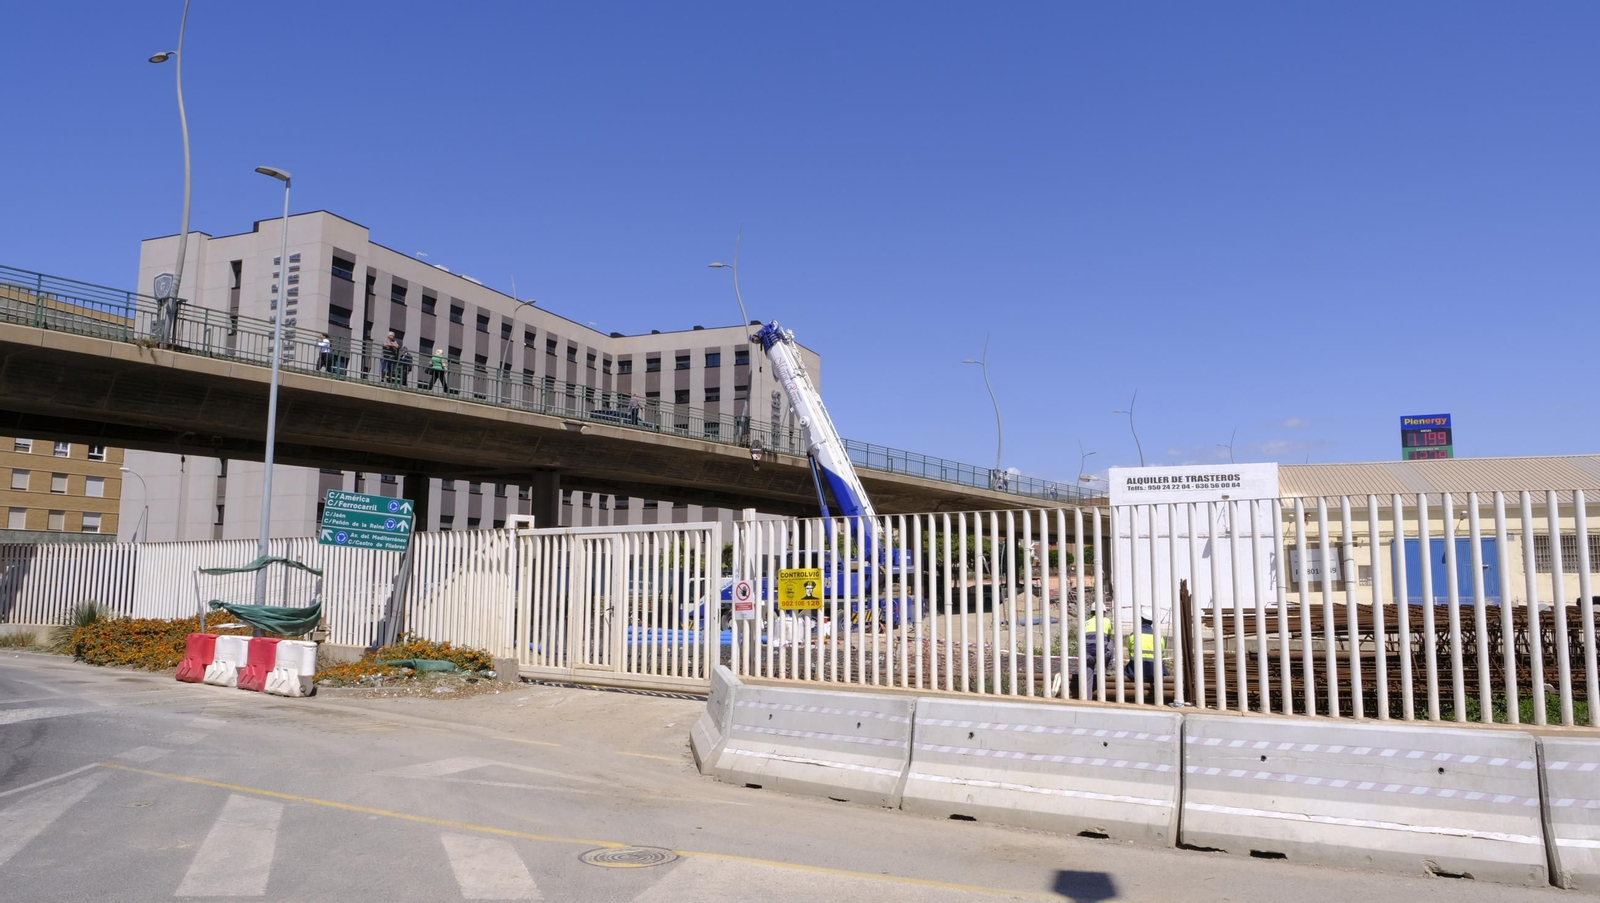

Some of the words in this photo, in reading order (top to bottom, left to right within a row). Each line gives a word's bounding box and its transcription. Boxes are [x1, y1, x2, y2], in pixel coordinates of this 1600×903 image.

[1404, 417, 1447, 425] Plenergy
[1126, 476, 1169, 485] ALQUILER
[1171, 475, 1183, 483] DE
[1185, 473, 1241, 482] TRASTEROS
[328, 491, 370, 503] C/América
[327, 499, 377, 511] C/Ferrocarril
[323, 518, 349, 526] C/Peñón
[372, 534, 407, 543] Mediterráneo
